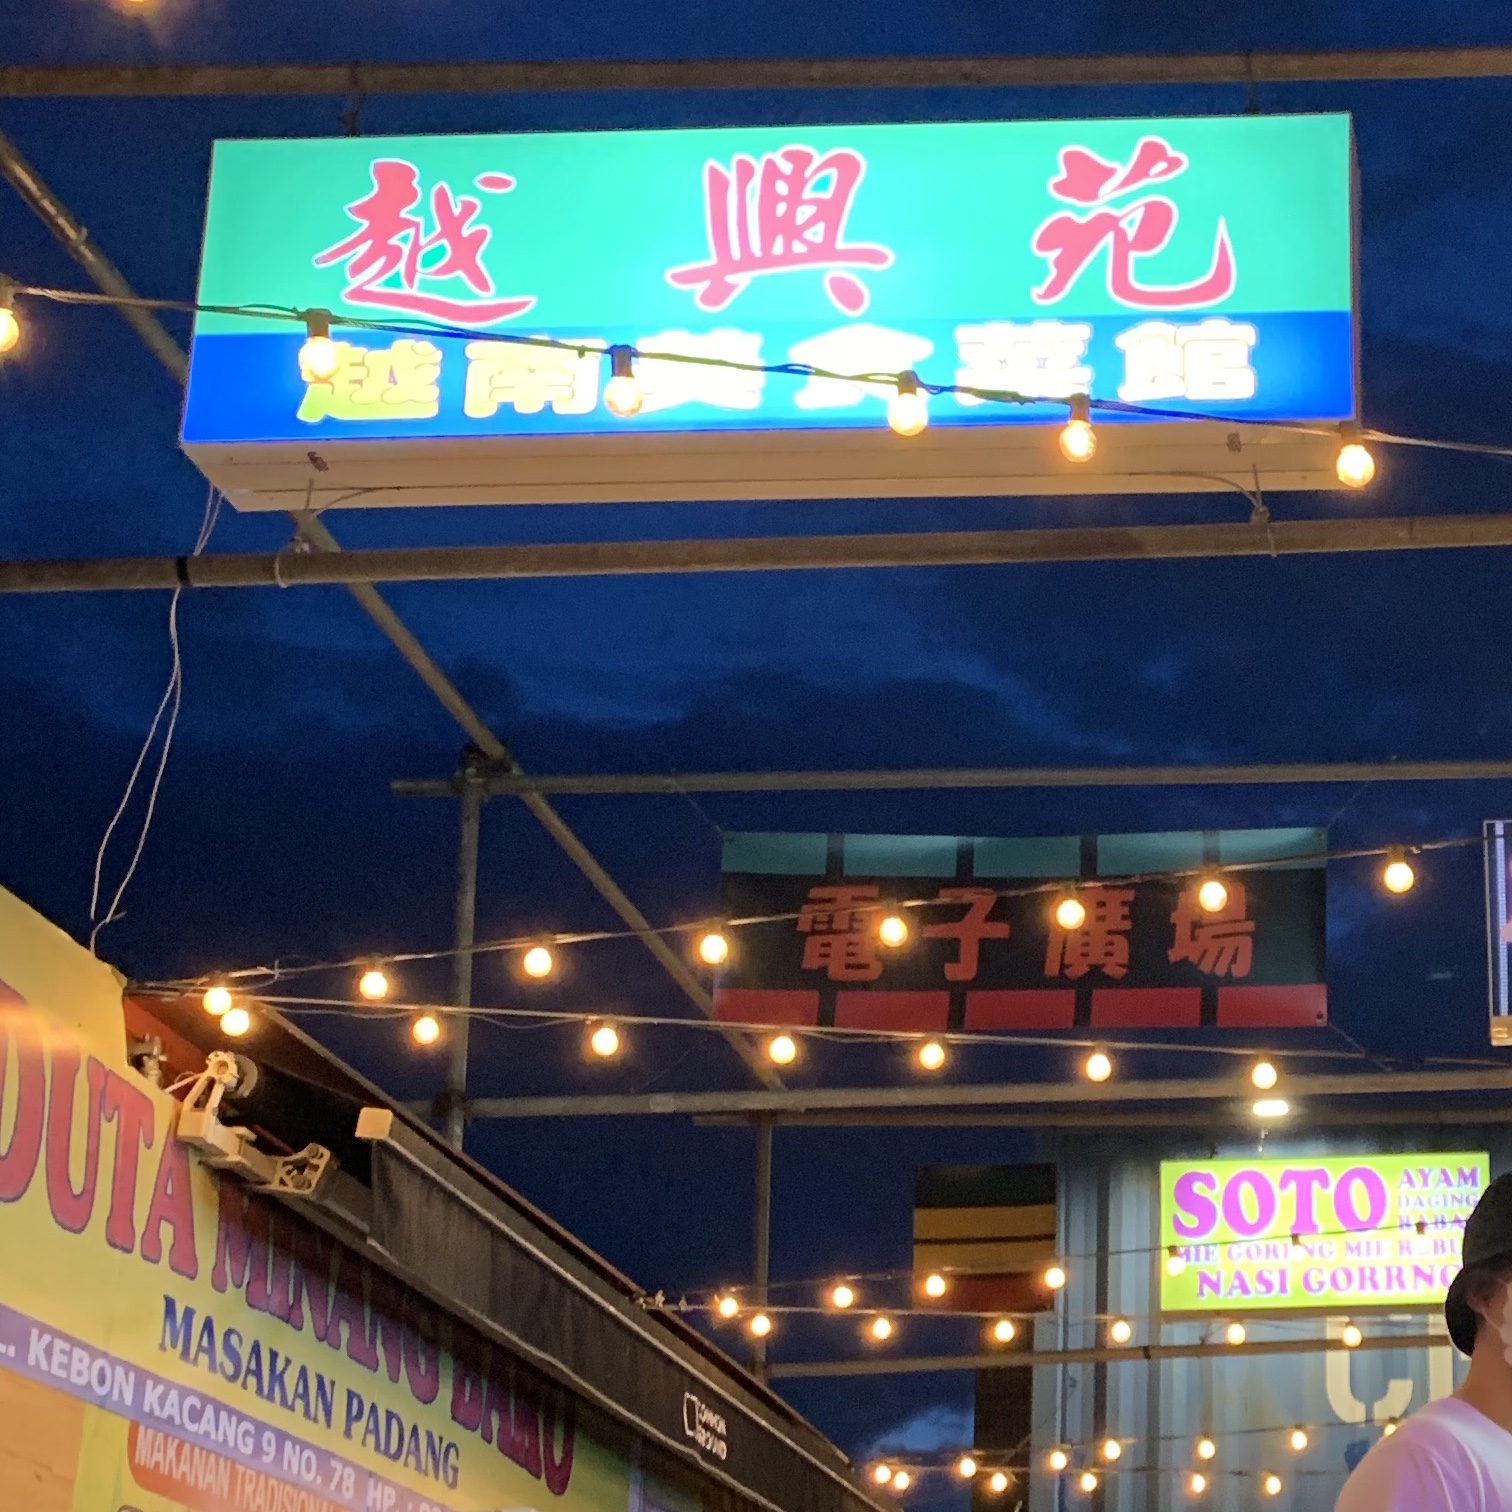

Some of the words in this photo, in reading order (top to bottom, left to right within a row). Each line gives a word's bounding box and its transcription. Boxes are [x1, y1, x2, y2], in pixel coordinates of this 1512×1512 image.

[0, 1036, 199, 1281] DUTA
[1172, 1166, 1388, 1239] SOTO
[1398, 1166, 1480, 1189] AYAM
[1197, 1267, 1290, 1299] NASI
[27, 1328, 136, 1406] KEBON
[143, 1378, 256, 1456] KACANG
[261, 1428, 278, 1464] 9
[282, 1439, 323, 1485] NO.
[329, 1460, 356, 1500] 78
[159, 1294, 336, 1430] MASAKAN
[342, 1386, 461, 1491] PADANG
[135, 1424, 232, 1500] MAKANAN
